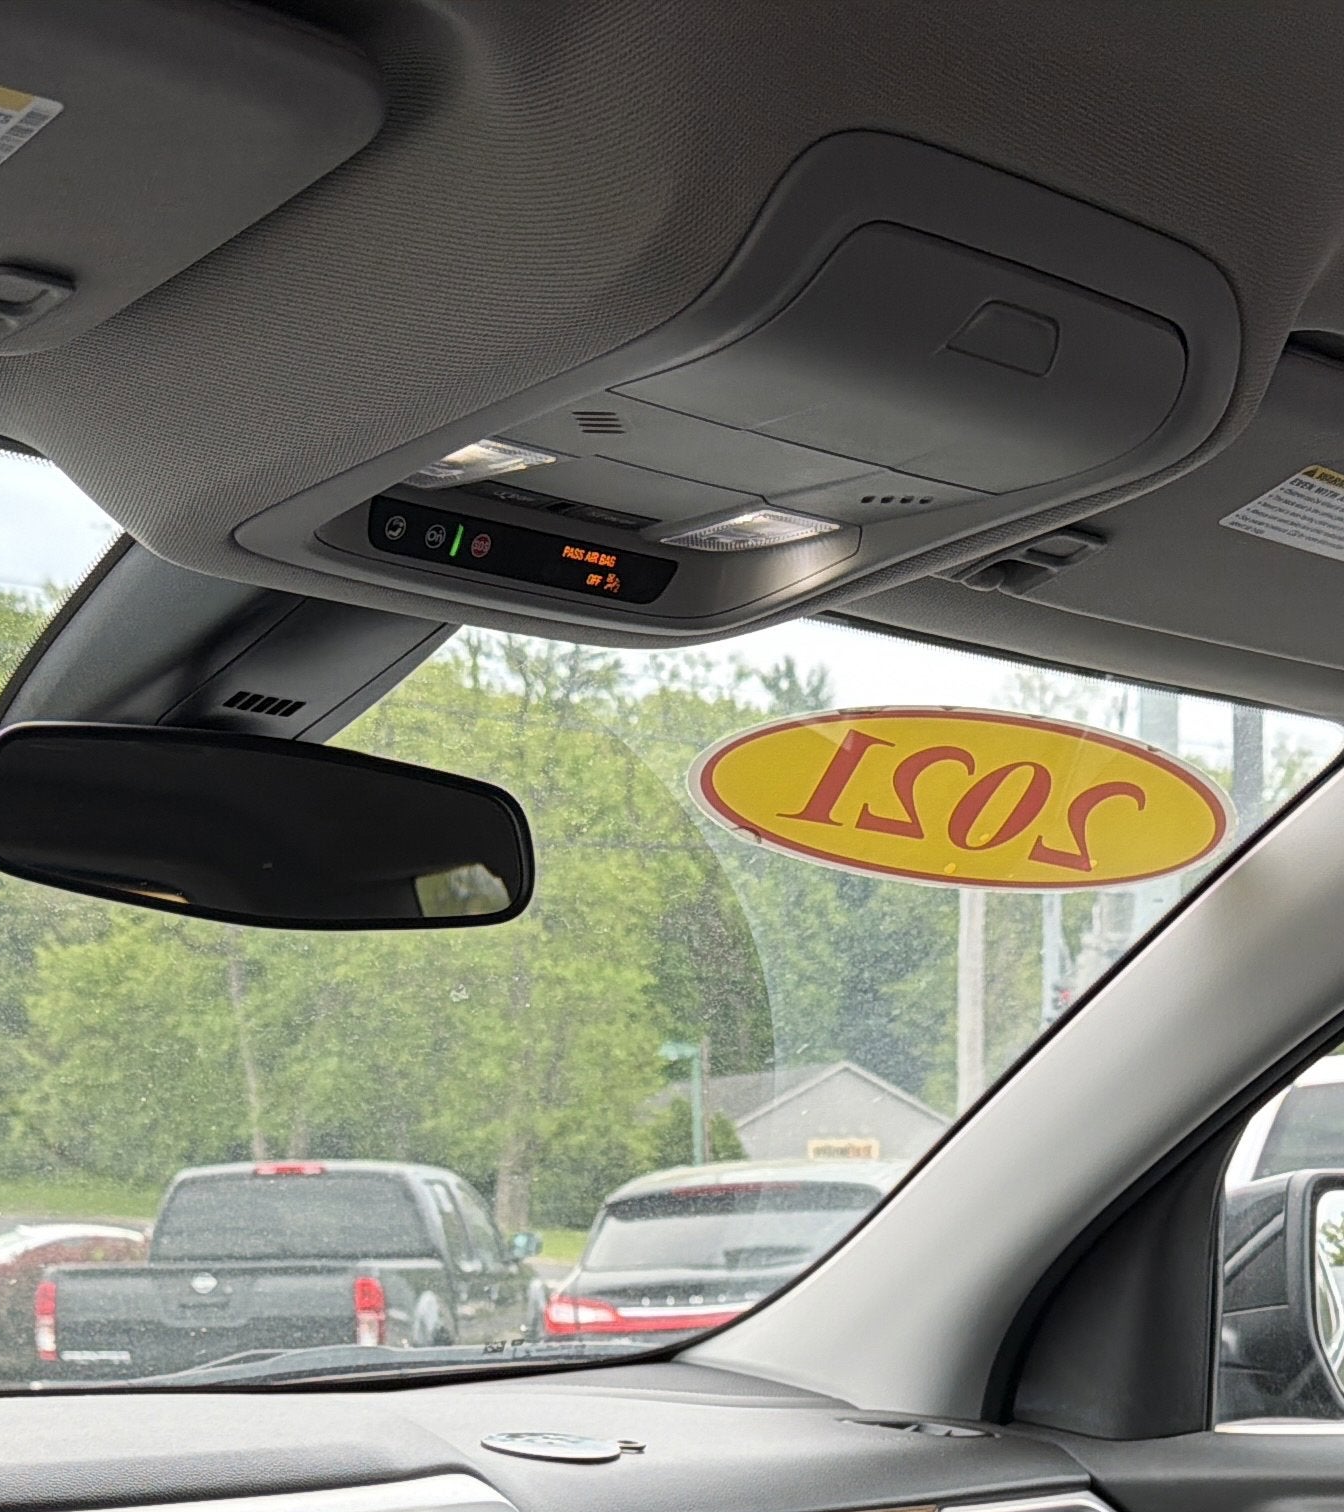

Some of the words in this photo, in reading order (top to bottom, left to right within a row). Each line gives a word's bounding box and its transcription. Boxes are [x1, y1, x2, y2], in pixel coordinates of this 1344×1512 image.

[562, 545, 585, 561] PASS
[584, 551, 600, 564] AIR
[598, 553, 617, 568] BAG
[586, 573, 603, 587] OFF
